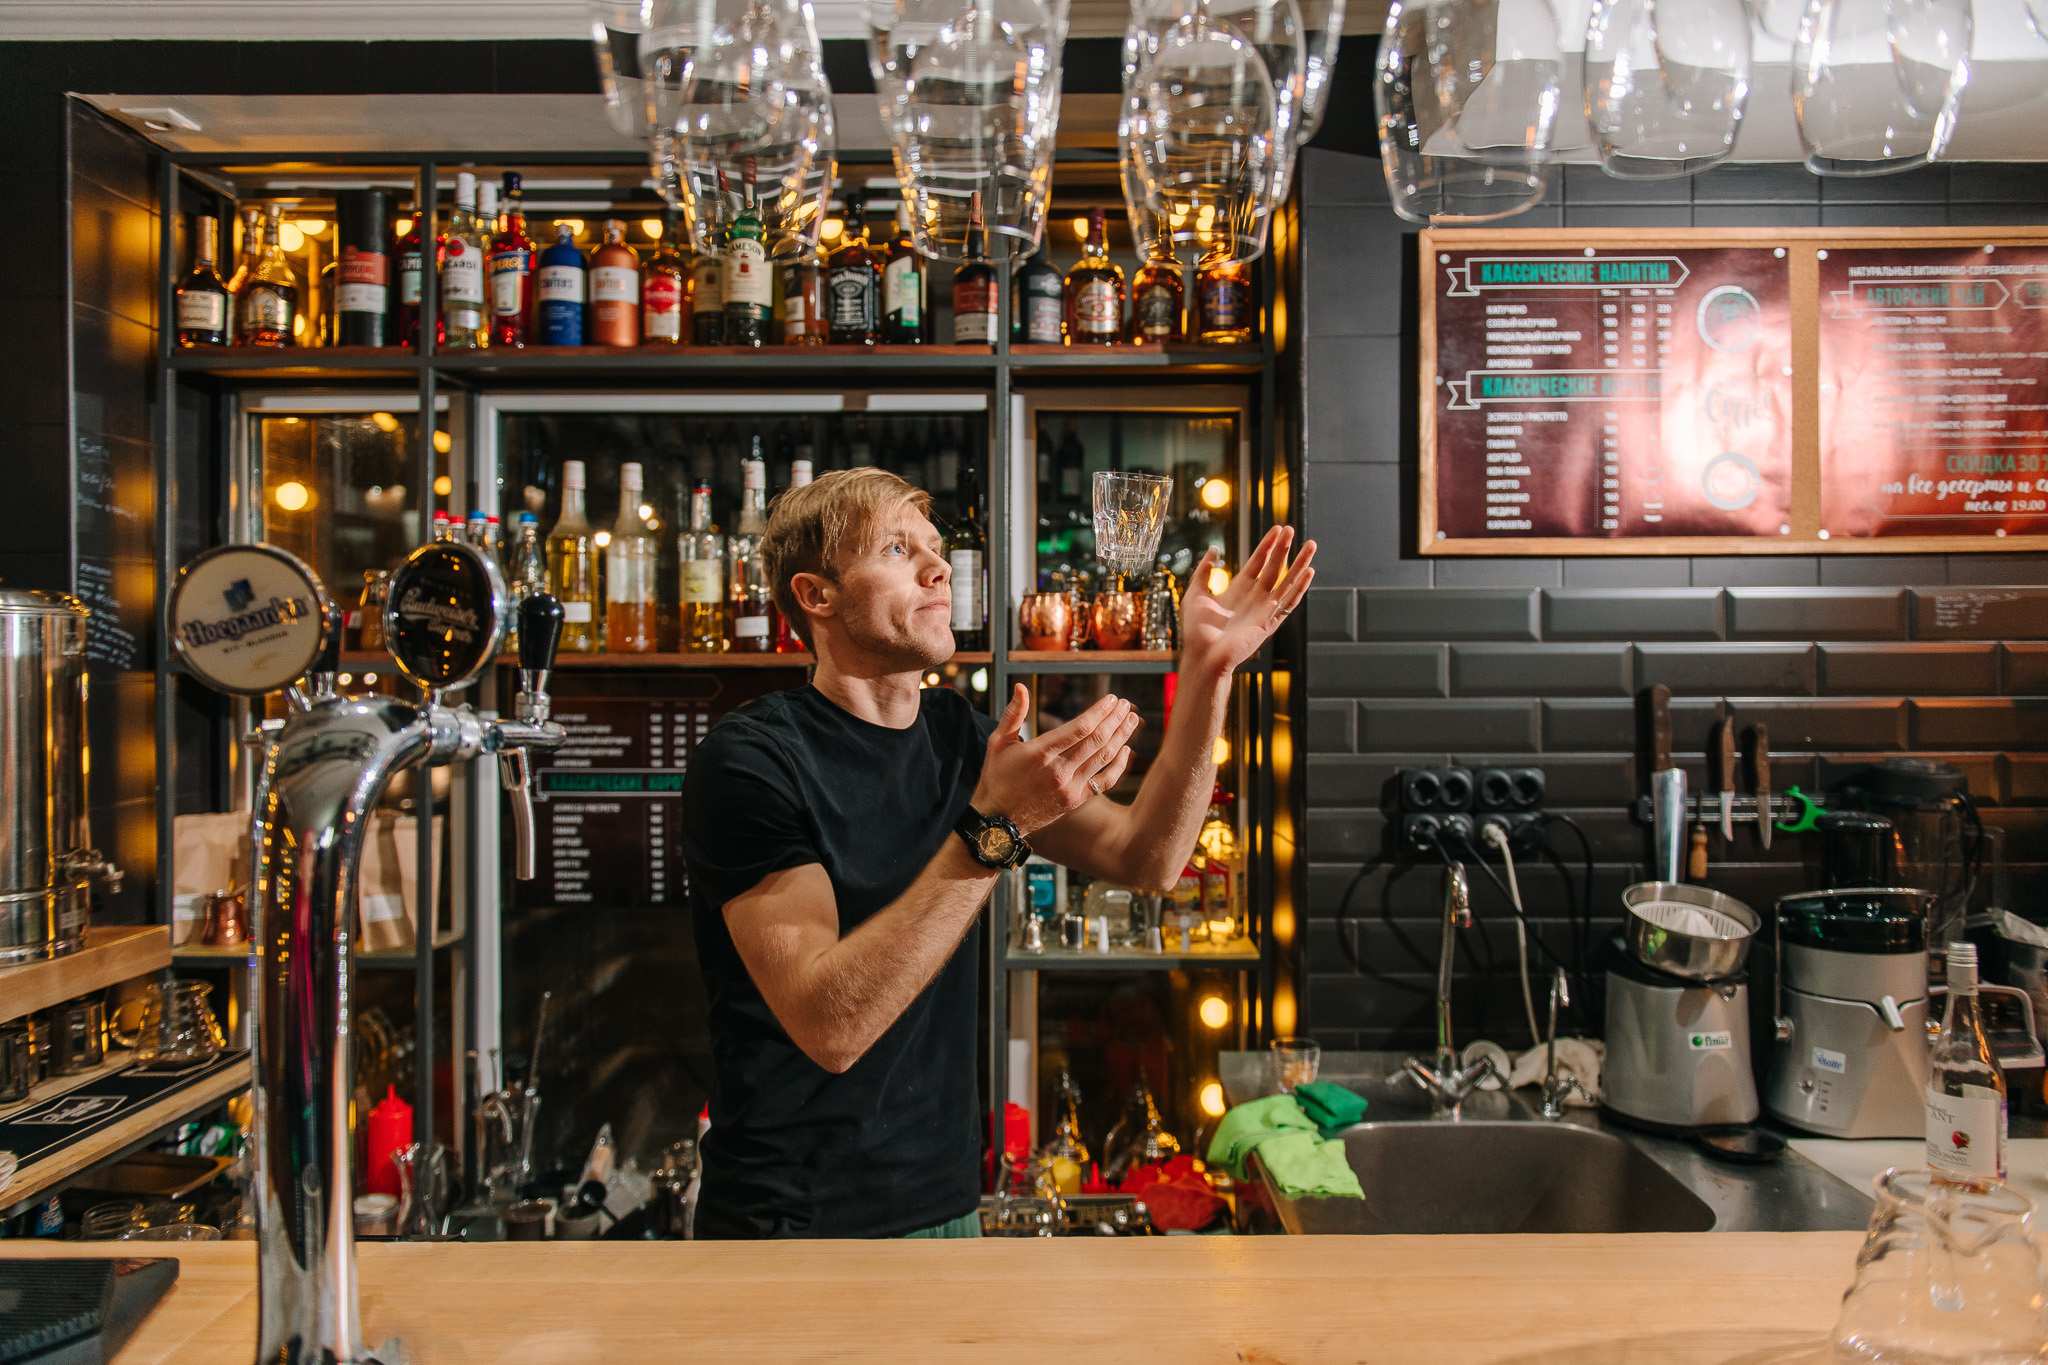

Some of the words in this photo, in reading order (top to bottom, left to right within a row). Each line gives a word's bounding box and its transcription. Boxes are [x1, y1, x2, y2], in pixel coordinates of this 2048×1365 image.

[1481, 263, 1595, 283] КЛАССИЧЕСКИЕ
[1600, 263, 1669, 283] НАПИТКИ
[1866, 282, 1950, 306] АВТОРСКИЙ
[1482, 377, 1596, 397] КЛАССИЧЕСКИЕ
[1947, 454, 2016, 475] СКИДКА
[2018, 454, 2040, 472] 30
[1908, 473, 1934, 495] все
[1937, 479, 2013, 500] десерты
[2017, 481, 2033, 493] и
[2011, 500, 2046, 511] 19.00
[181, 596, 309, 648] Hoegaarden
